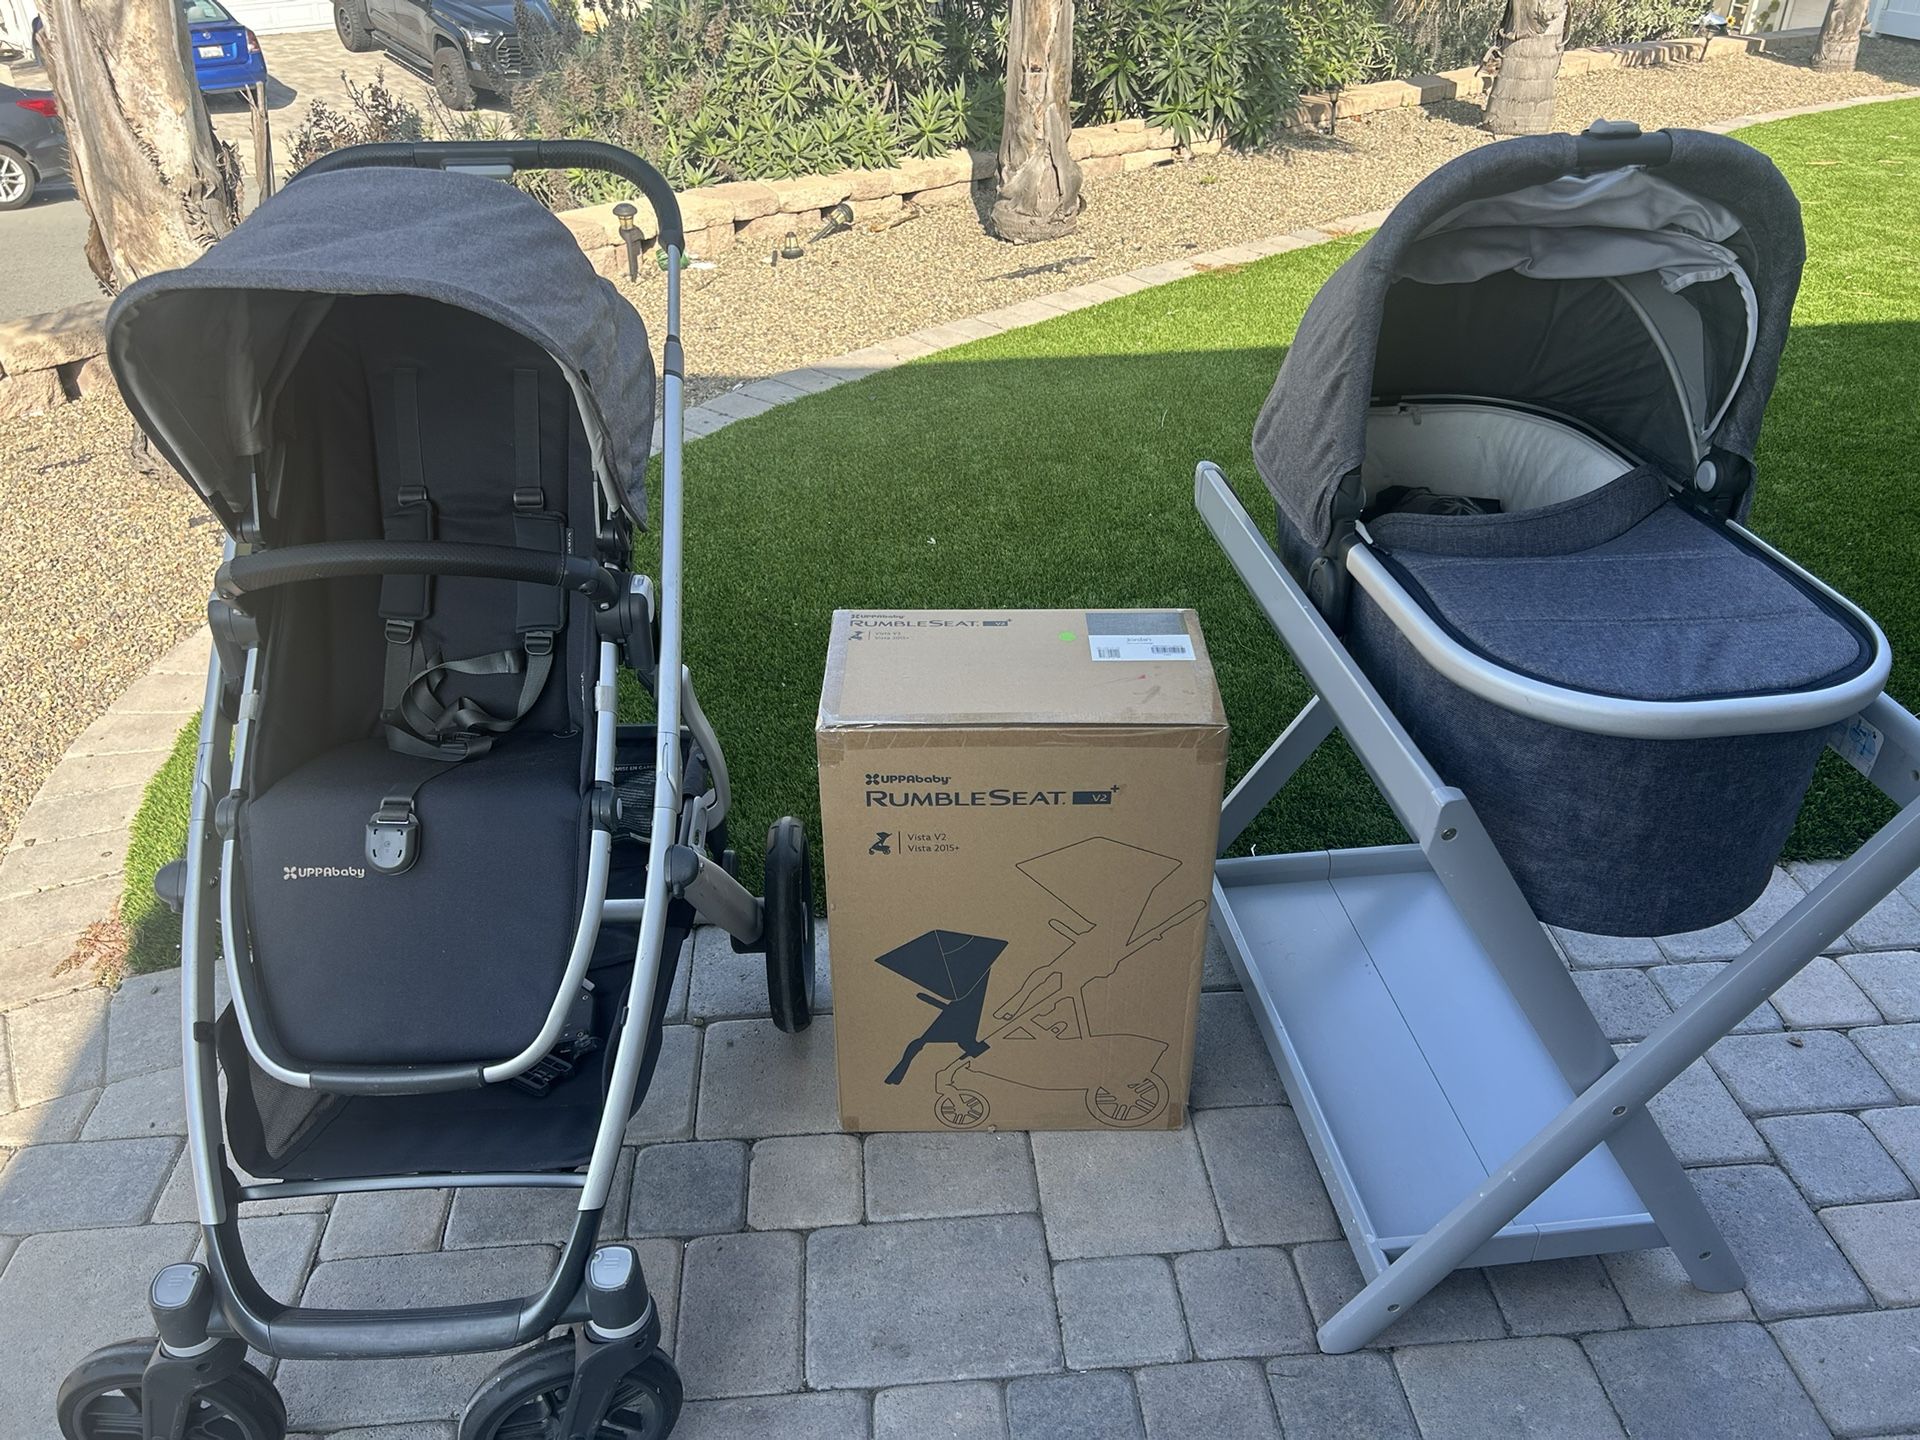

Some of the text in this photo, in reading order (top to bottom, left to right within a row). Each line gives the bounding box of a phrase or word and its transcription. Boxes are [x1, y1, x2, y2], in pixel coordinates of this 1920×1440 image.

[880, 774, 951, 786] UPPAbaby
[907, 832, 947, 842] Vista V2
[907, 843, 960, 853] Vista 2015+
[298, 866, 366, 879] UPPAbaby
